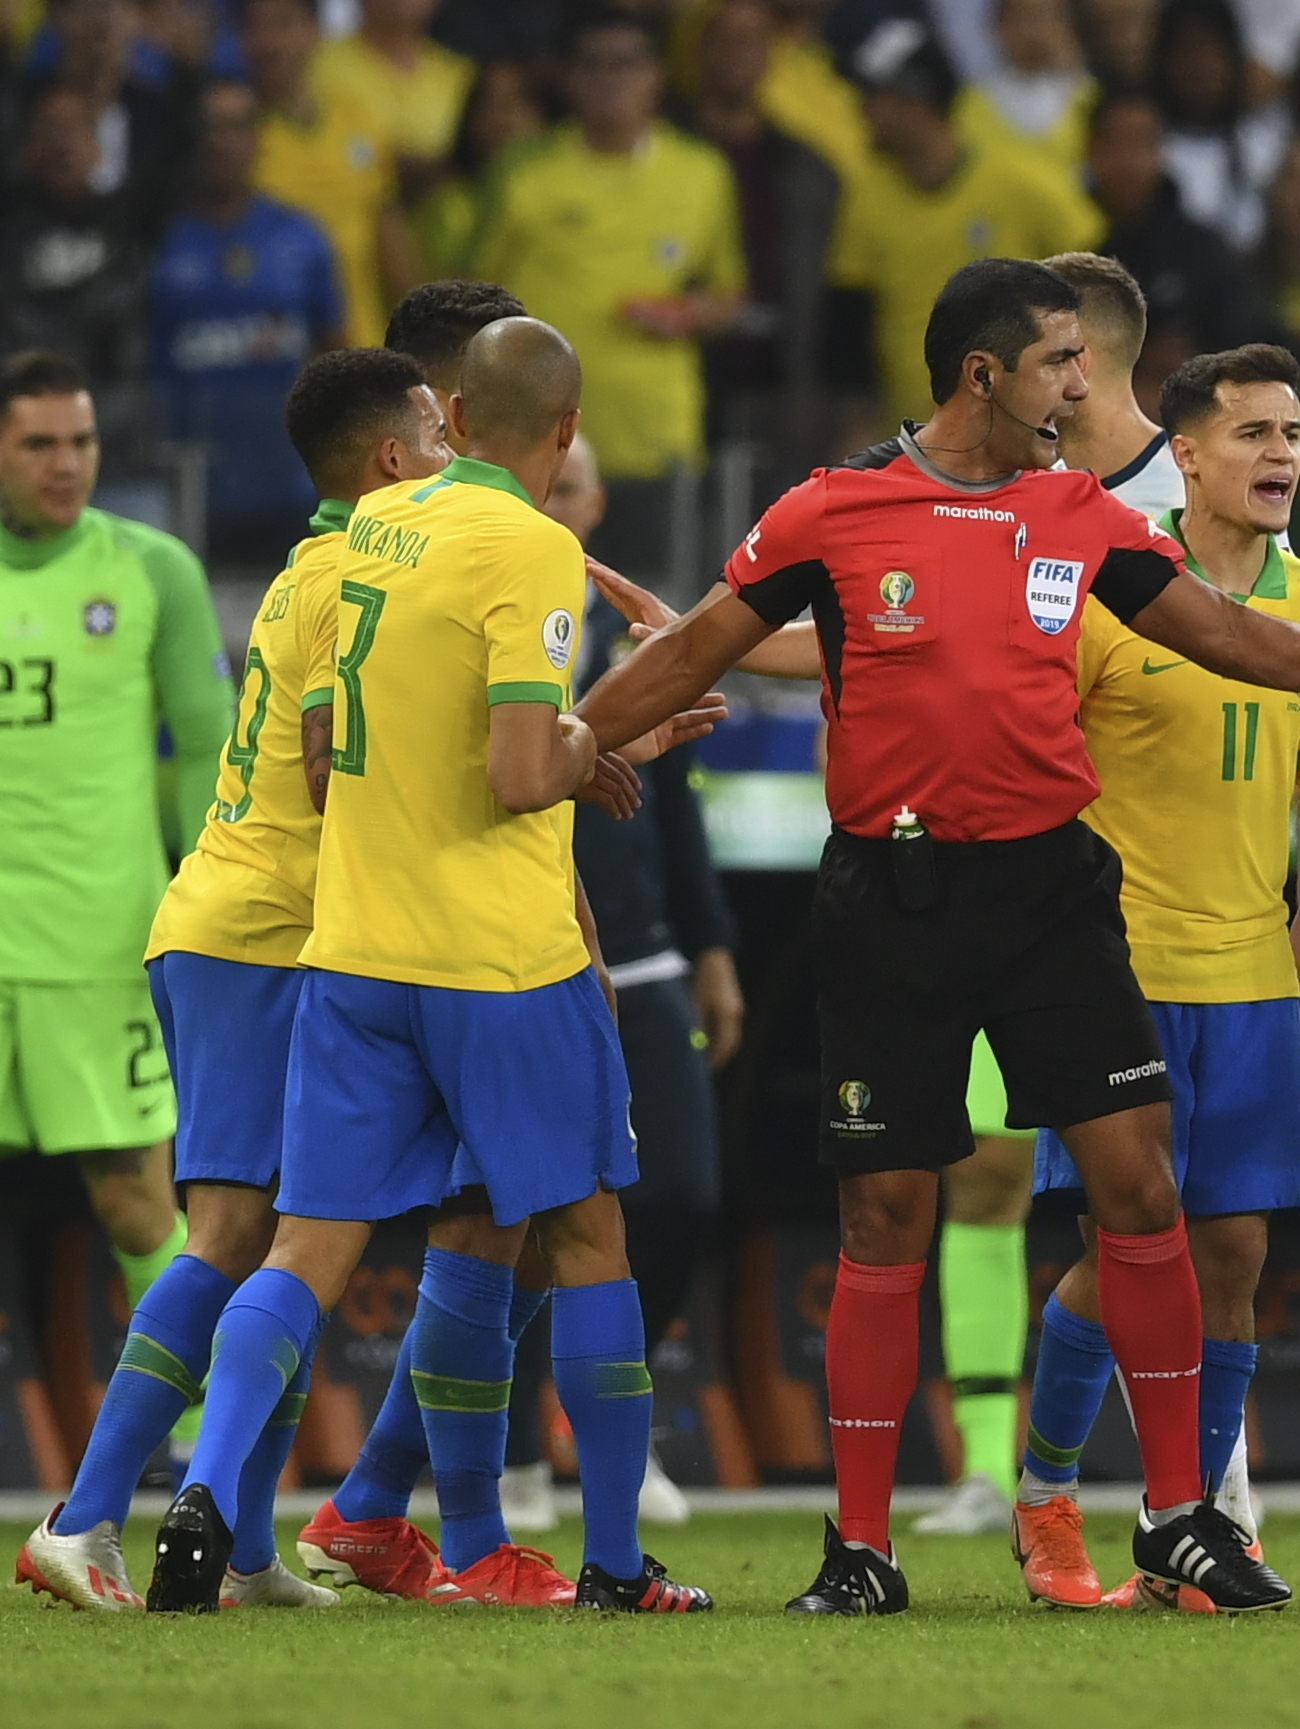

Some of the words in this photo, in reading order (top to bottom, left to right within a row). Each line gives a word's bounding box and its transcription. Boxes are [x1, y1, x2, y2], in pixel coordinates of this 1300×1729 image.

[933, 505, 1015, 523] marathon
[1033, 561, 1074, 584] FIFA
[1030, 591, 1072, 606] REFEREE
[1041, 618, 1060, 630] 2019
[332, 579, 388, 777] 3
[217, 646, 272, 824] 9
[1222, 702, 1260, 781] 11
[830, 1120, 848, 1130] COPA
[330, 1543, 388, 1555] NEMESIS
